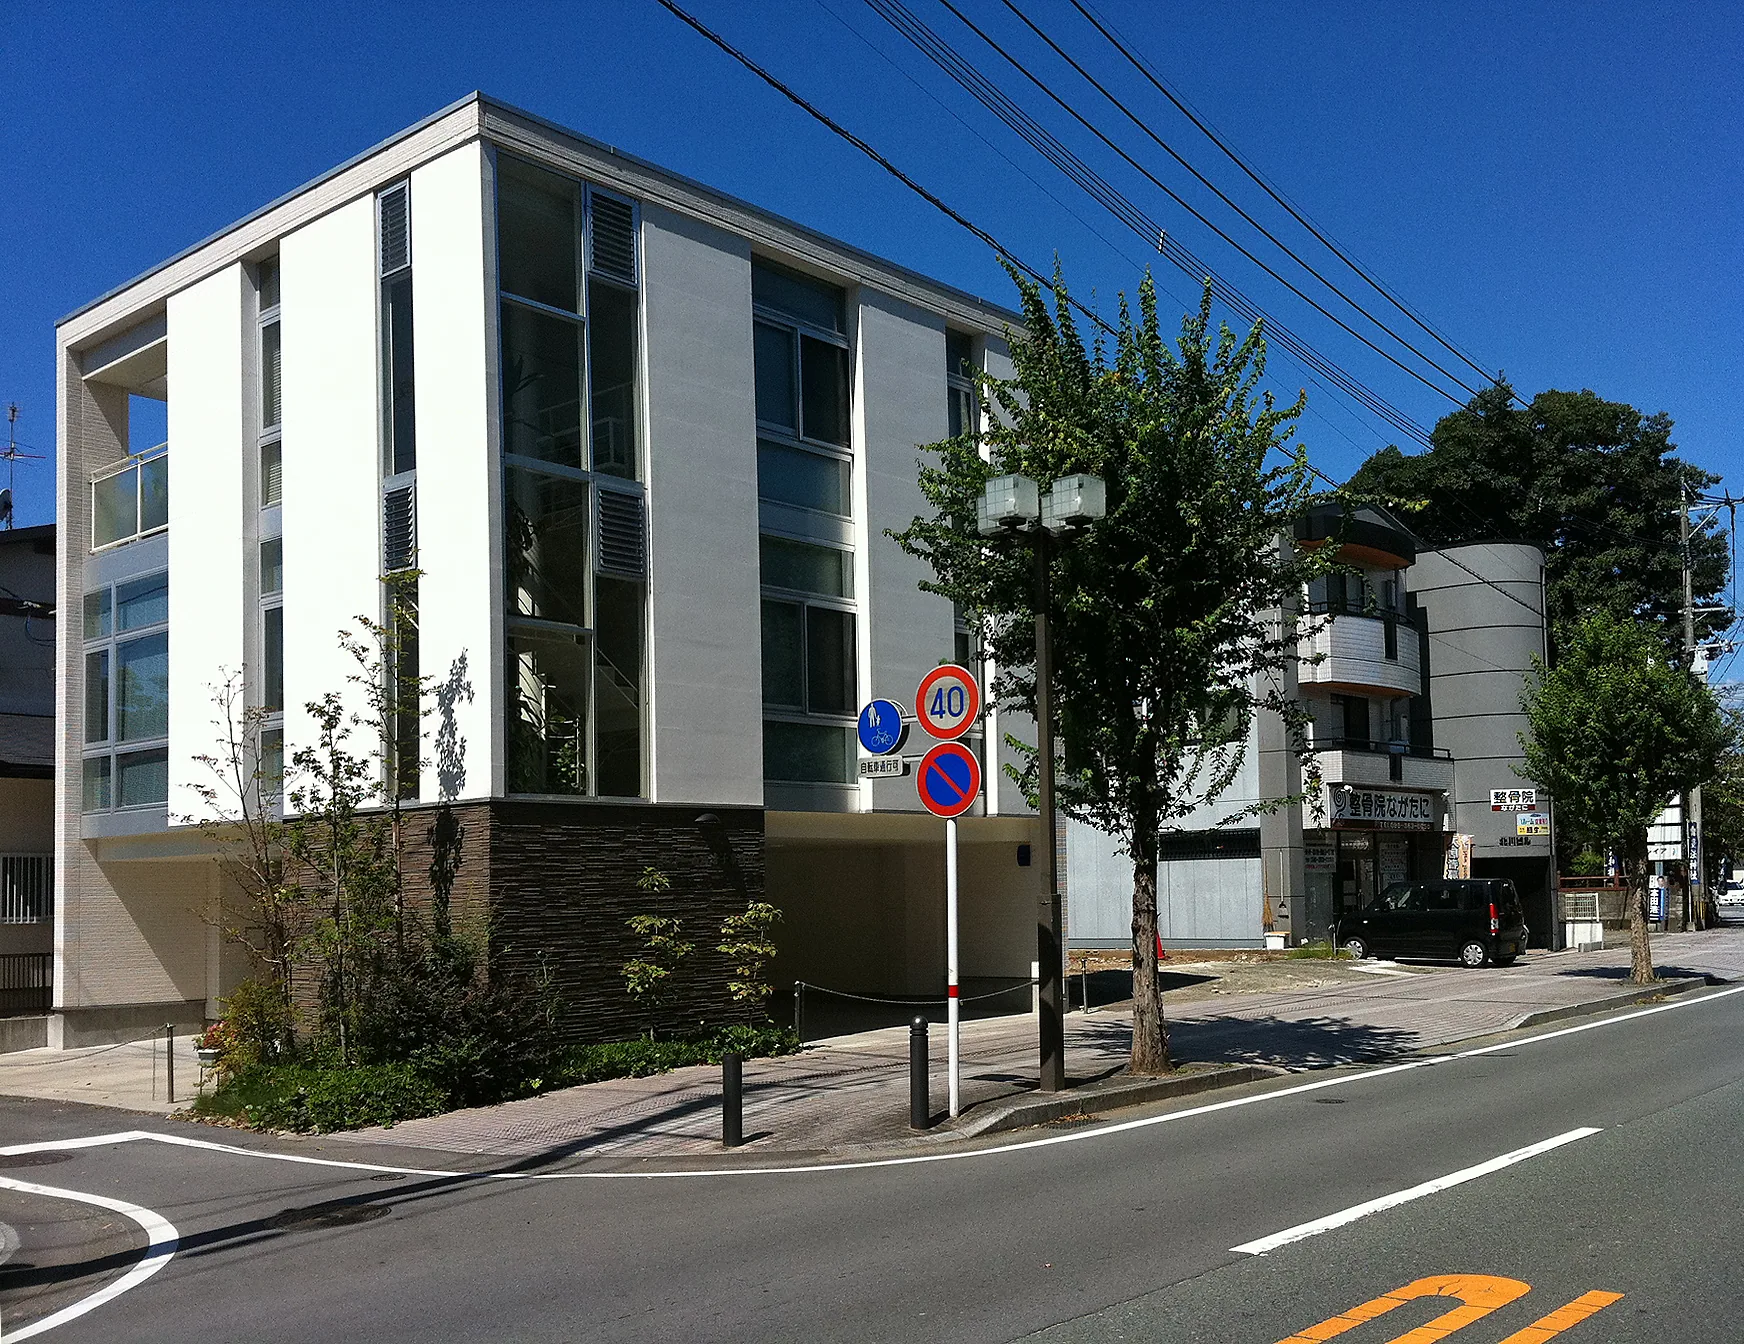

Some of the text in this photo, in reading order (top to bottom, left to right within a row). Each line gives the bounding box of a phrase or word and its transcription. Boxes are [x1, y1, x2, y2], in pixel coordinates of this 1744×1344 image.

[931, 686, 964, 719] 40
[860, 759, 899, 774] 自転車通行可
[1349, 791, 1430, 818] 整骨院ながたに
[1493, 790, 1534, 804] 整骨院
[1500, 804, 1529, 812] ながたに
